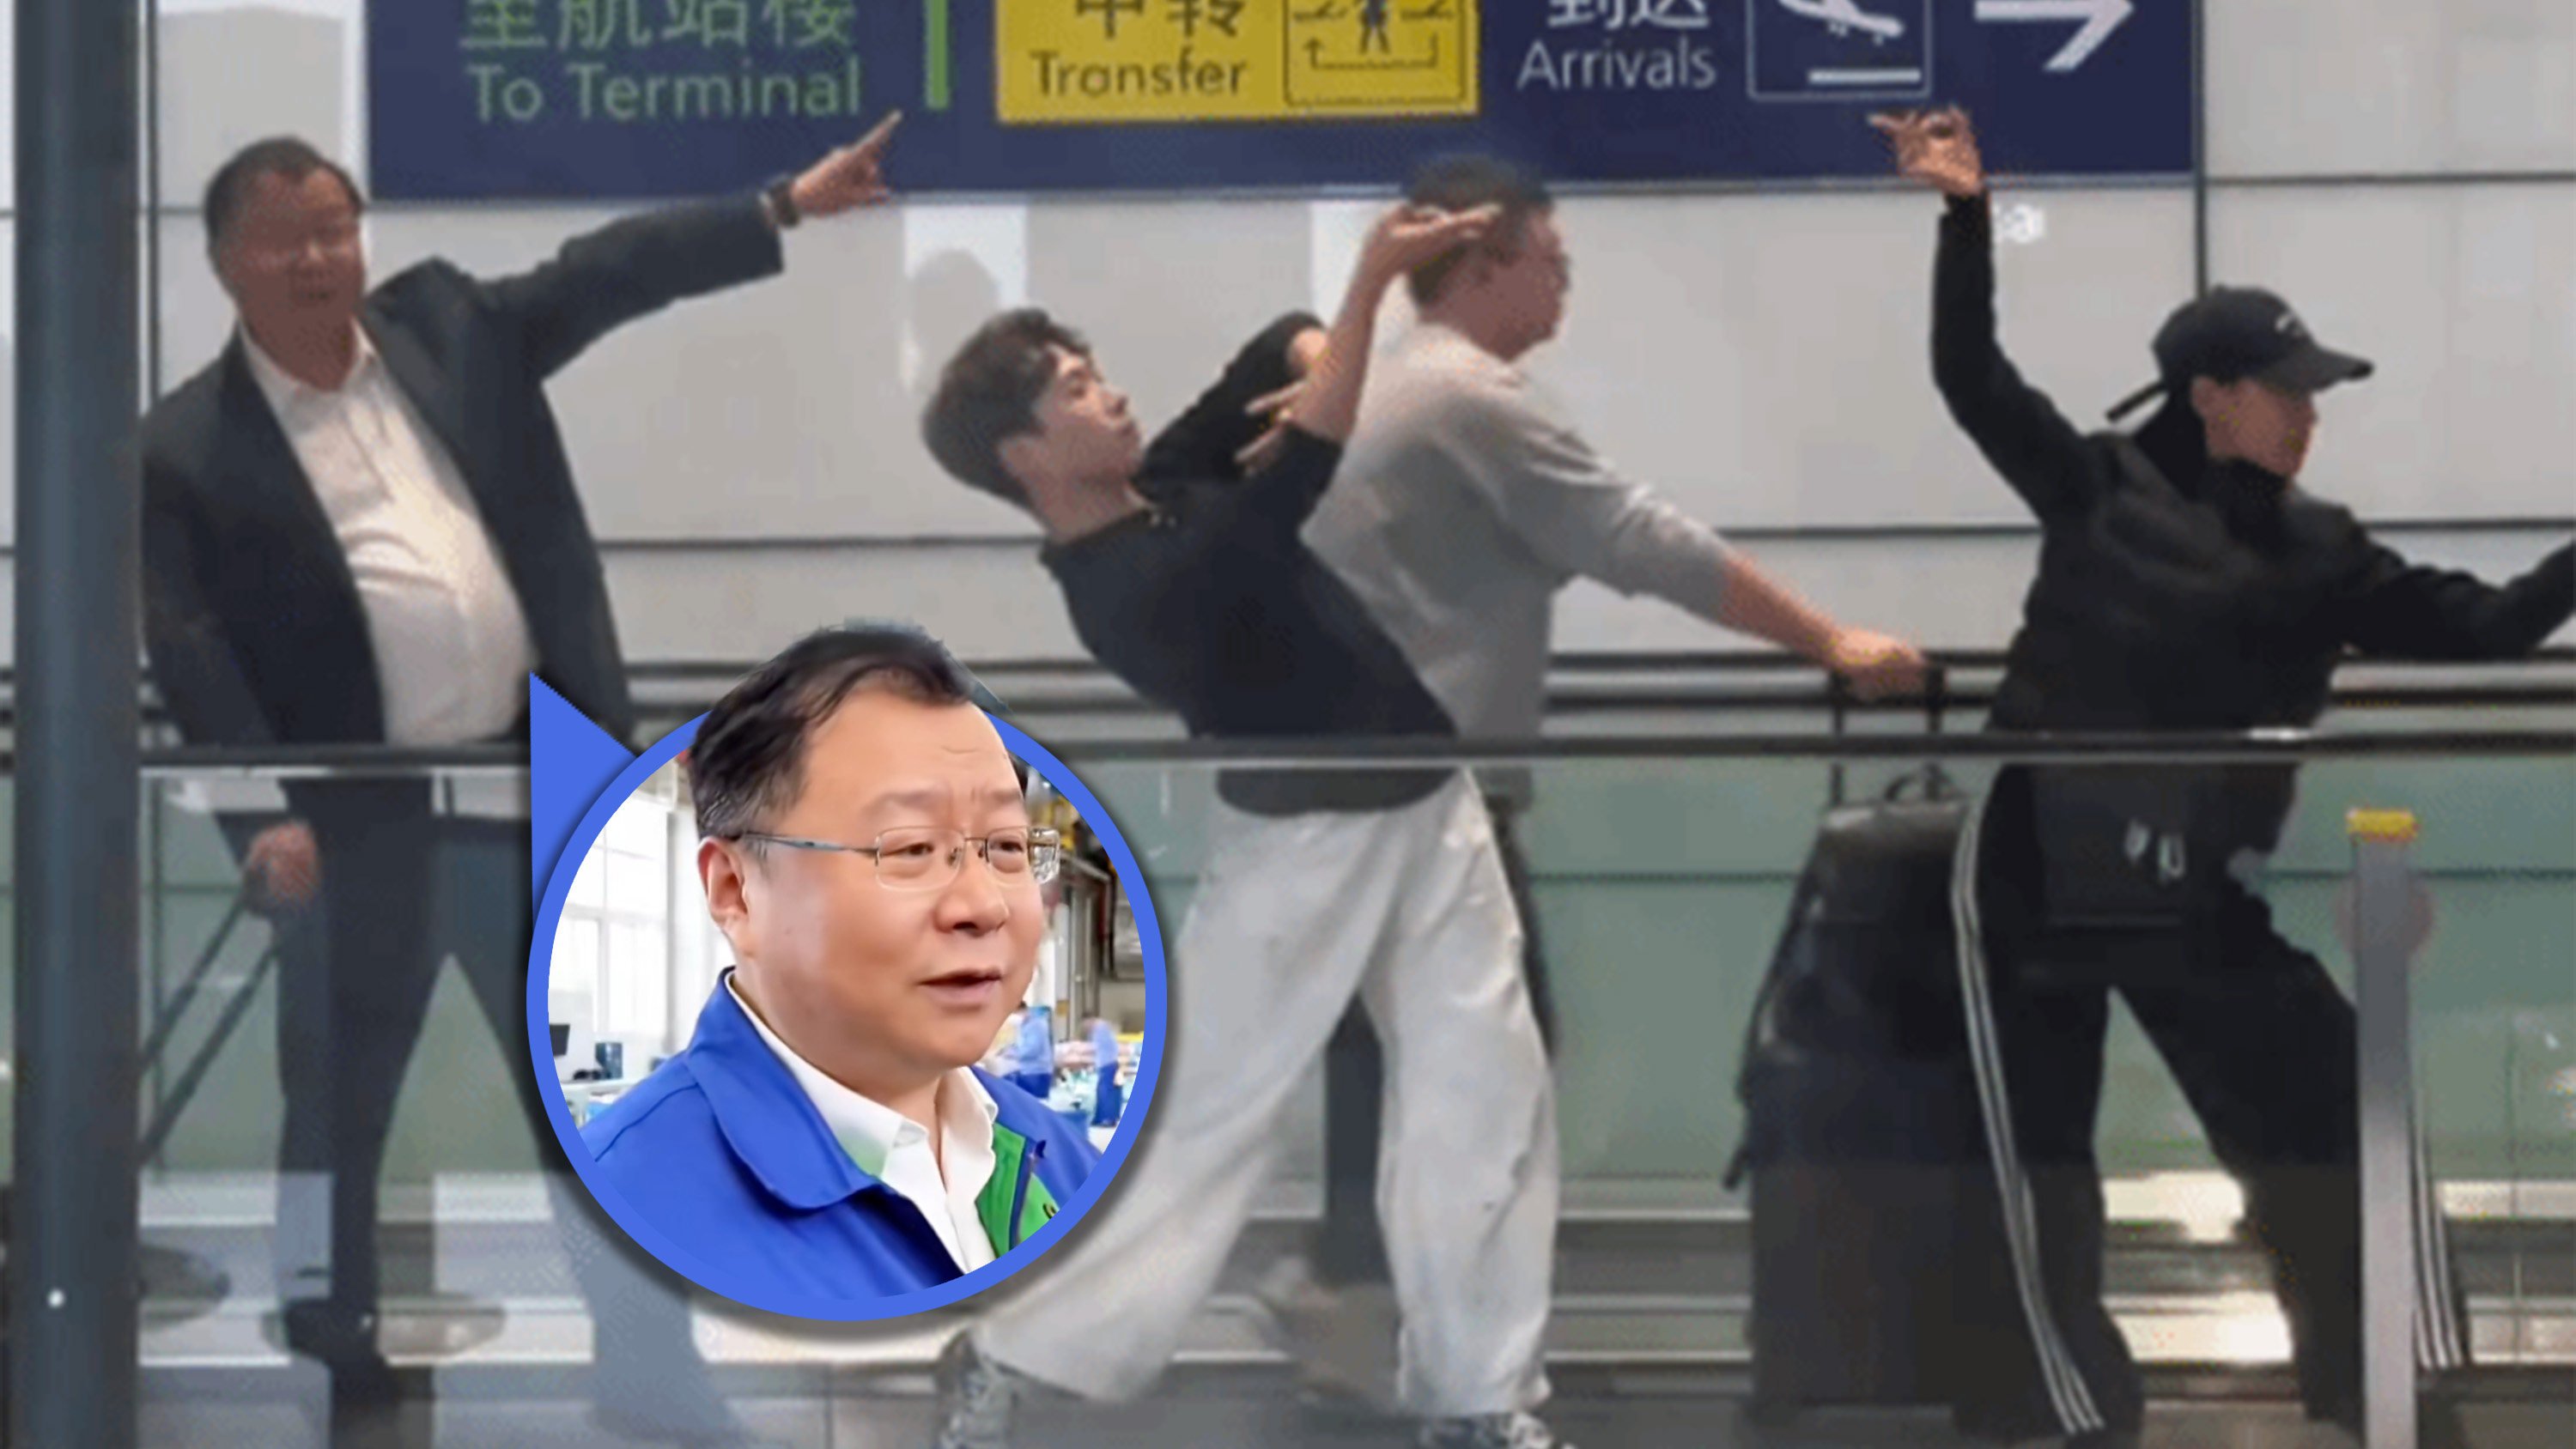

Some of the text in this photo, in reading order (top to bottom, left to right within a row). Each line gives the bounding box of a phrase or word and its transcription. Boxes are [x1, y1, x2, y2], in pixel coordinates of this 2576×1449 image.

[467, 56, 860, 122] To Terminal
[1031, 45, 1249, 95] Transfer
[1517, 34, 1716, 89] Arrivals
